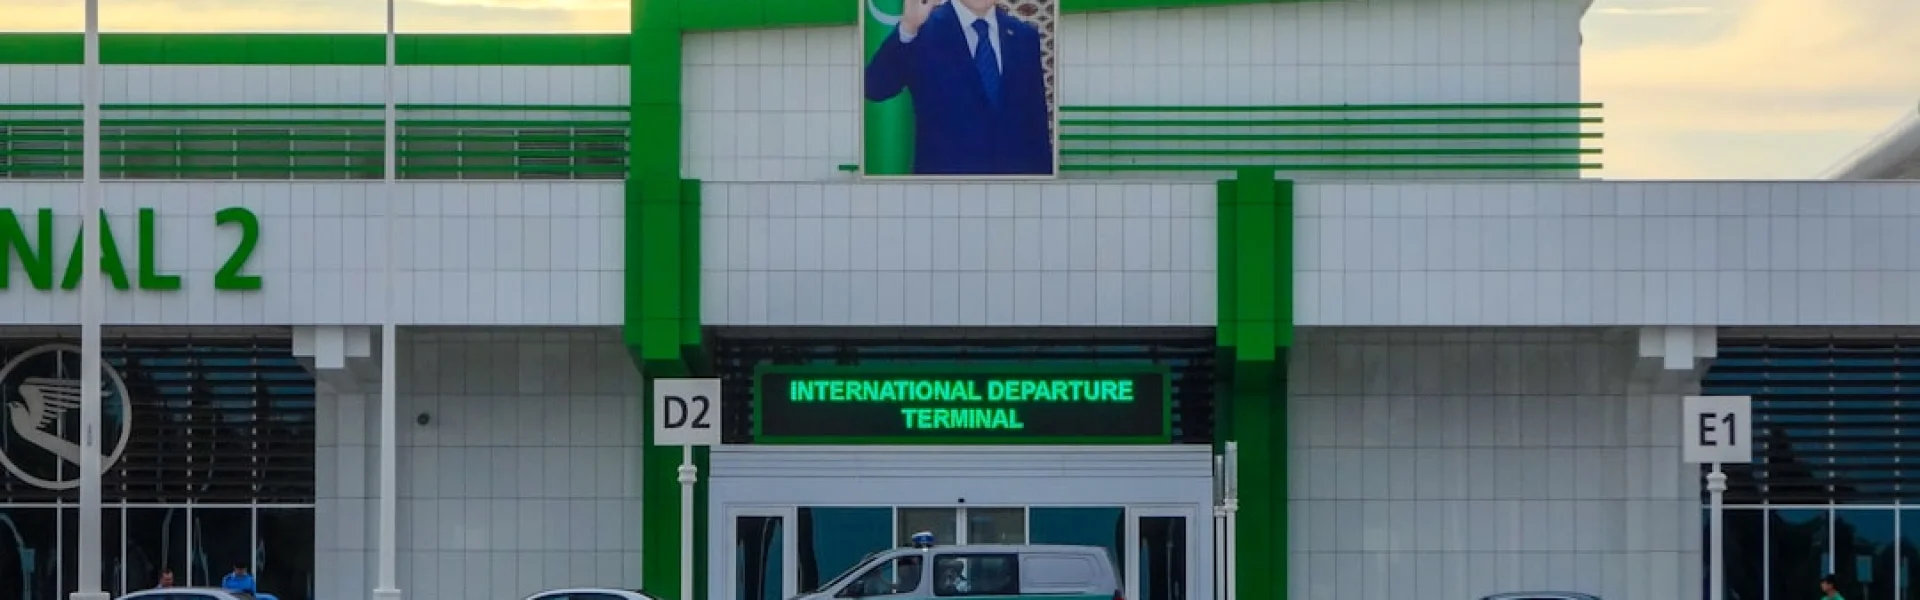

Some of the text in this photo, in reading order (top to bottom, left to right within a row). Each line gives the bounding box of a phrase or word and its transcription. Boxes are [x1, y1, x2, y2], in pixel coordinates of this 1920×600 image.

[215, 207, 262, 289] 2
[790, 380, 1134, 401] INTERNATIONAL DEPARTURE
[664, 395, 710, 428] D2
[901, 408, 1024, 429] TERMINAL
[1699, 412, 1735, 446] E1
